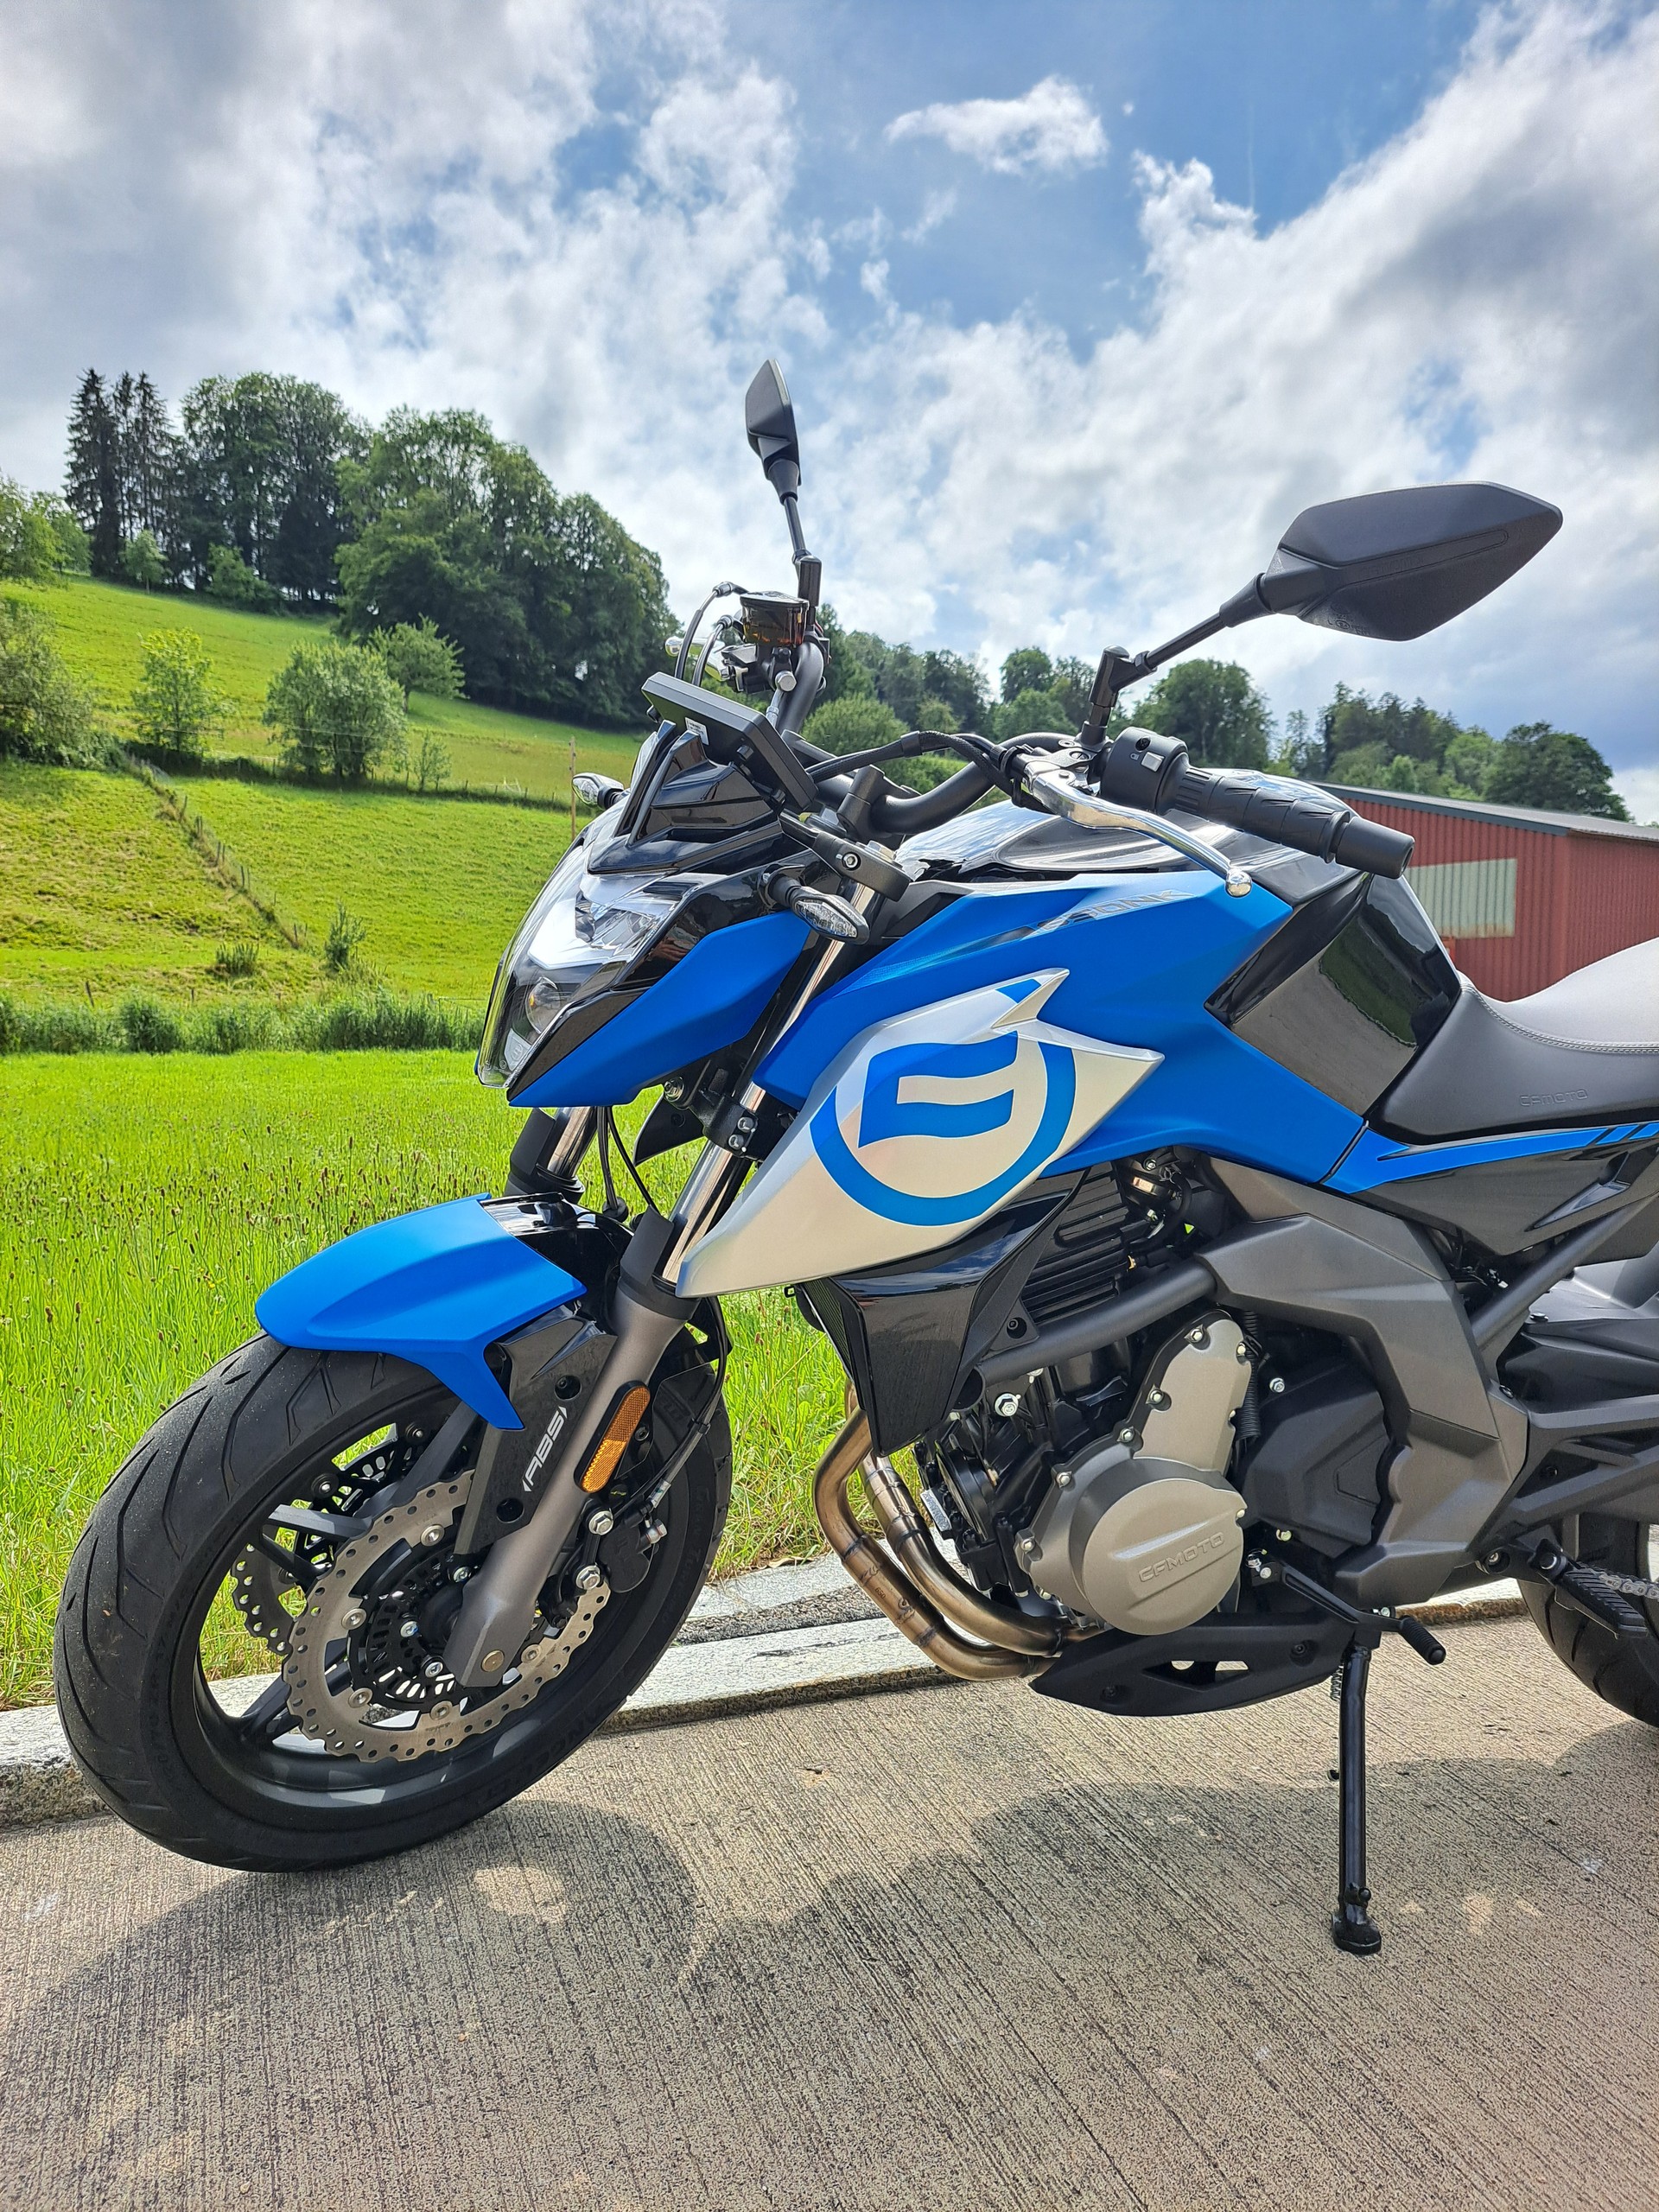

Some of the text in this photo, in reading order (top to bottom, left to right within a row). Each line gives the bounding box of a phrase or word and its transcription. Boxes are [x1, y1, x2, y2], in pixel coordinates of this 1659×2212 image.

[1036, 889, 1196, 931] 650NK
[1519, 1089, 1589, 1107] CFMOTO
[524, 1409, 565, 1486] ABS
[1138, 1531, 1225, 1583] CFMOTO
